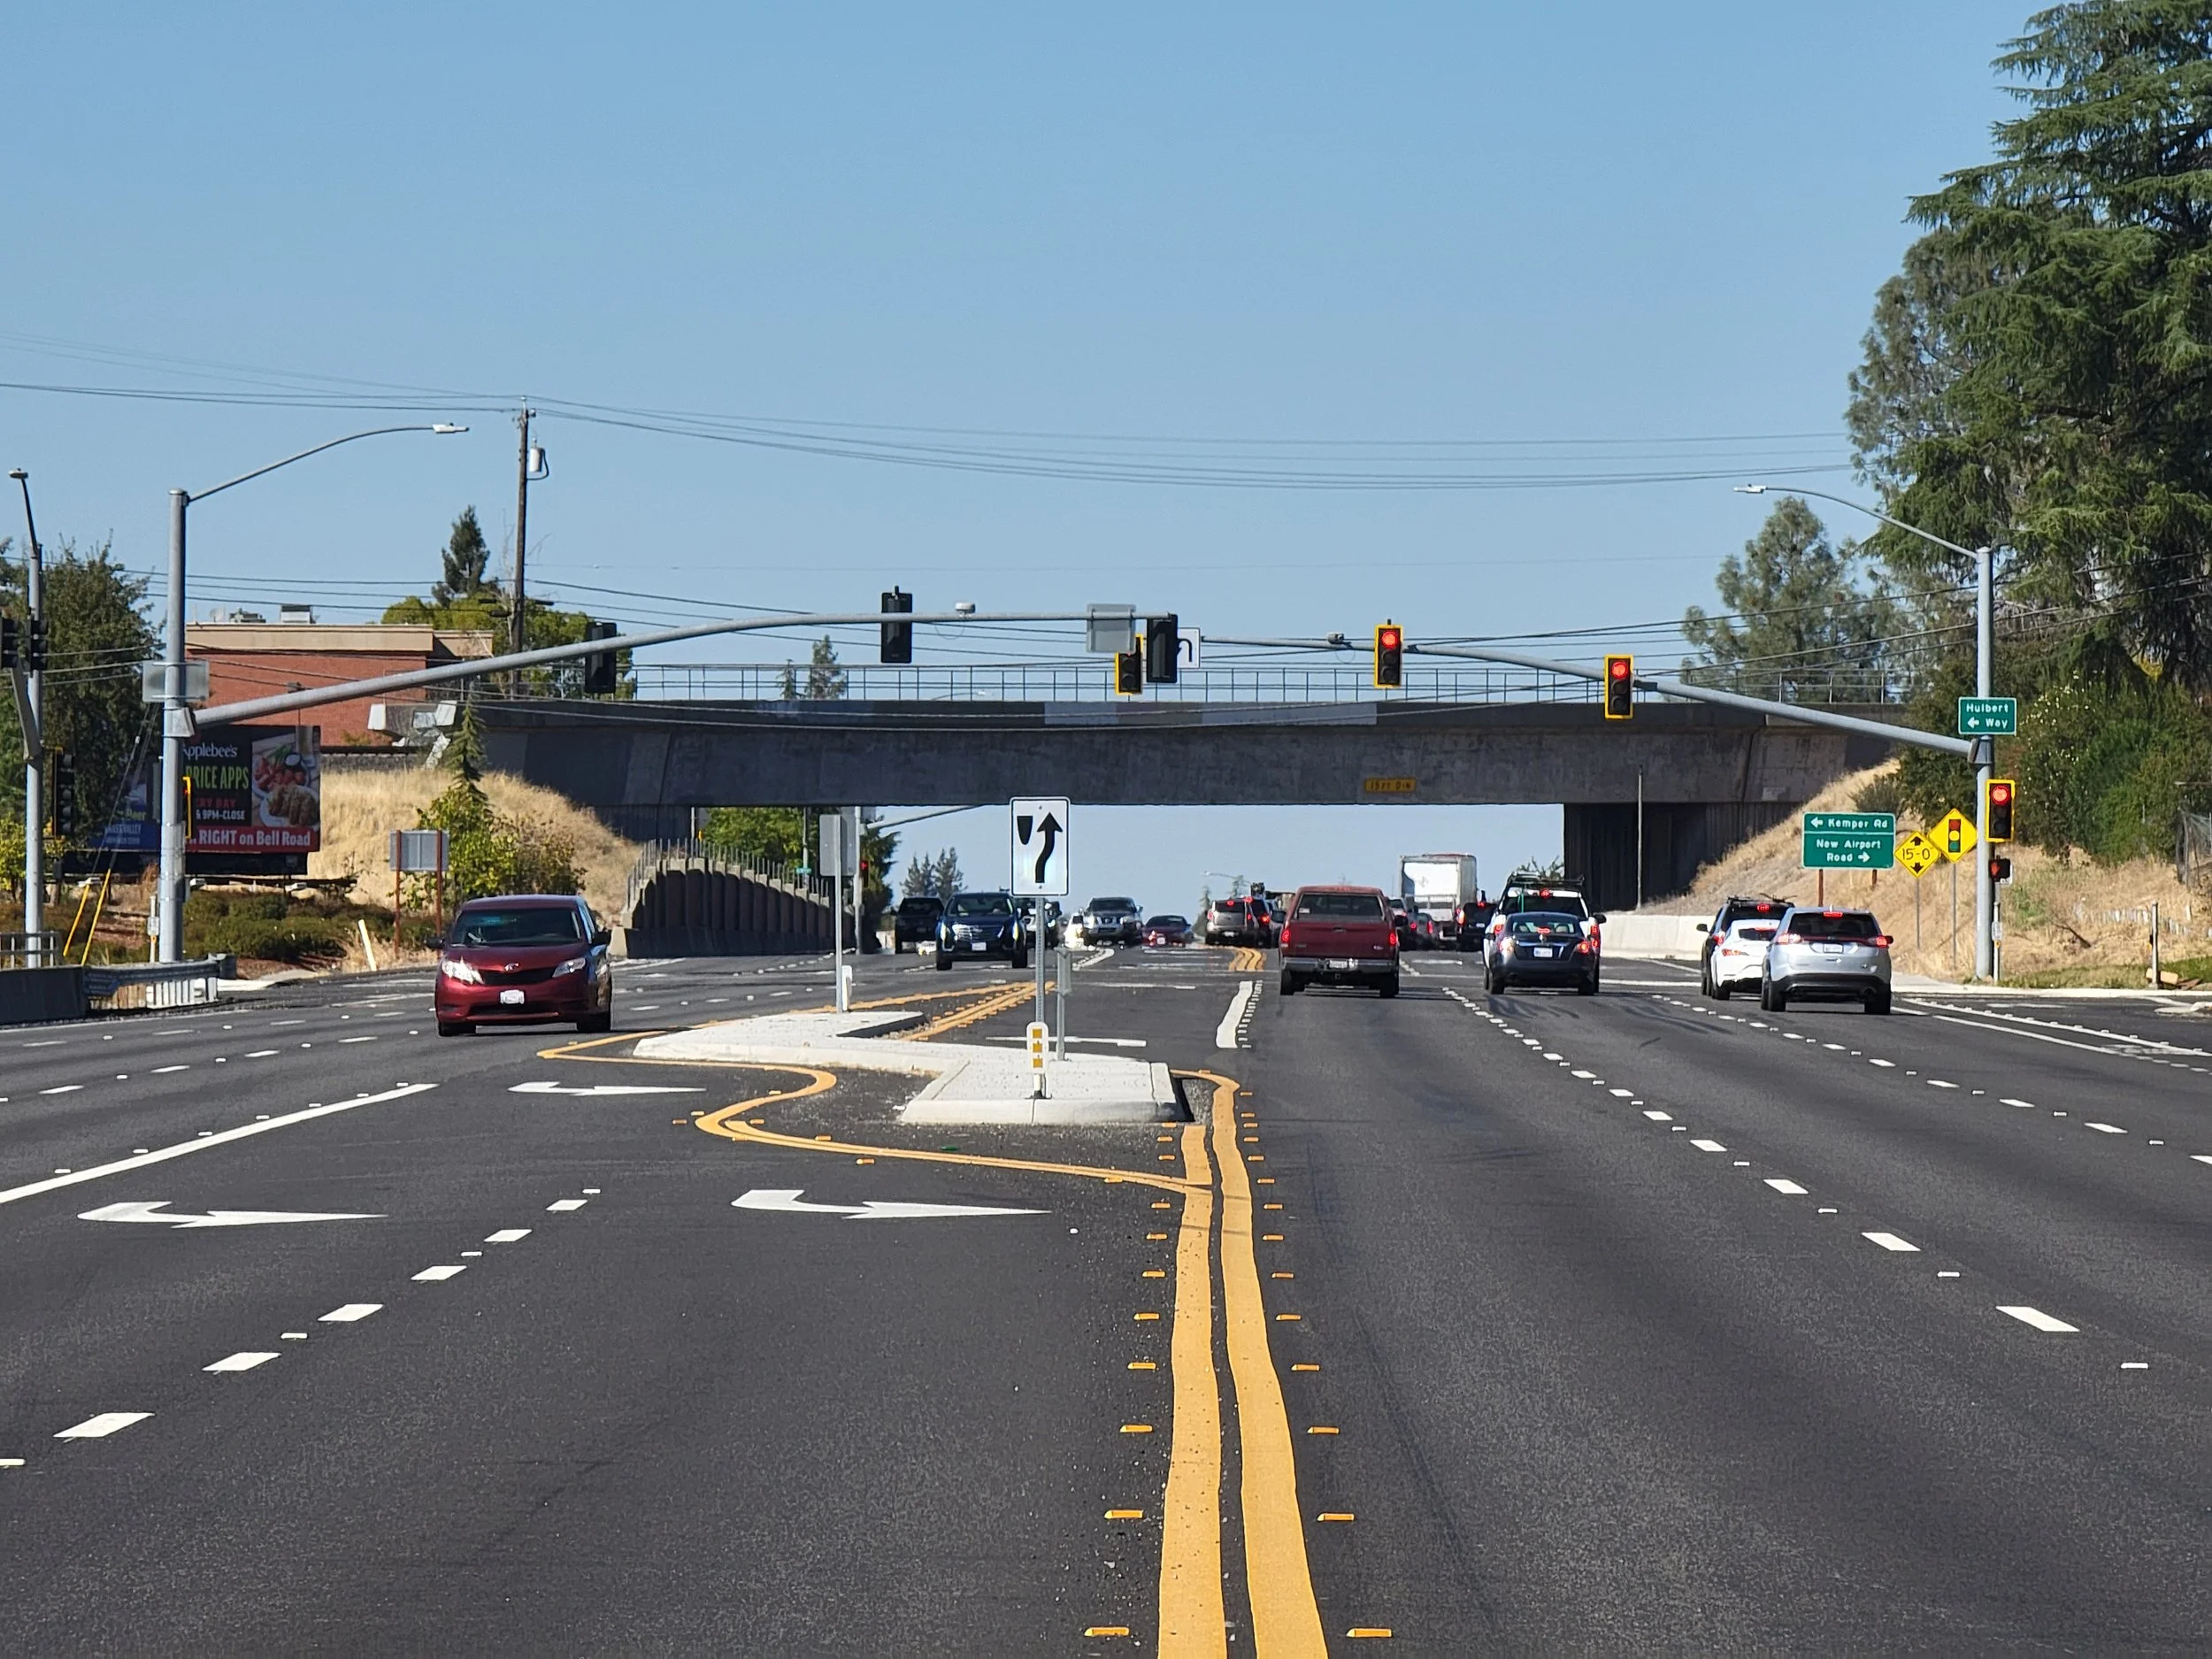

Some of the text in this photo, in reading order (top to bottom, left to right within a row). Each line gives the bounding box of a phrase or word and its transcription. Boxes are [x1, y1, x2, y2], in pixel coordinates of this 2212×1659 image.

[1966, 703, 2008, 713] Hulbert
[1985, 718, 2008, 729] Way
[220, 765, 249, 790] APPS
[1828, 818, 1887, 830] Kemper Rd
[199, 829, 311, 847] RIGHT on Bell Road
[1816, 838, 1881, 850] New Airport
[1826, 852, 1853, 862] Road
